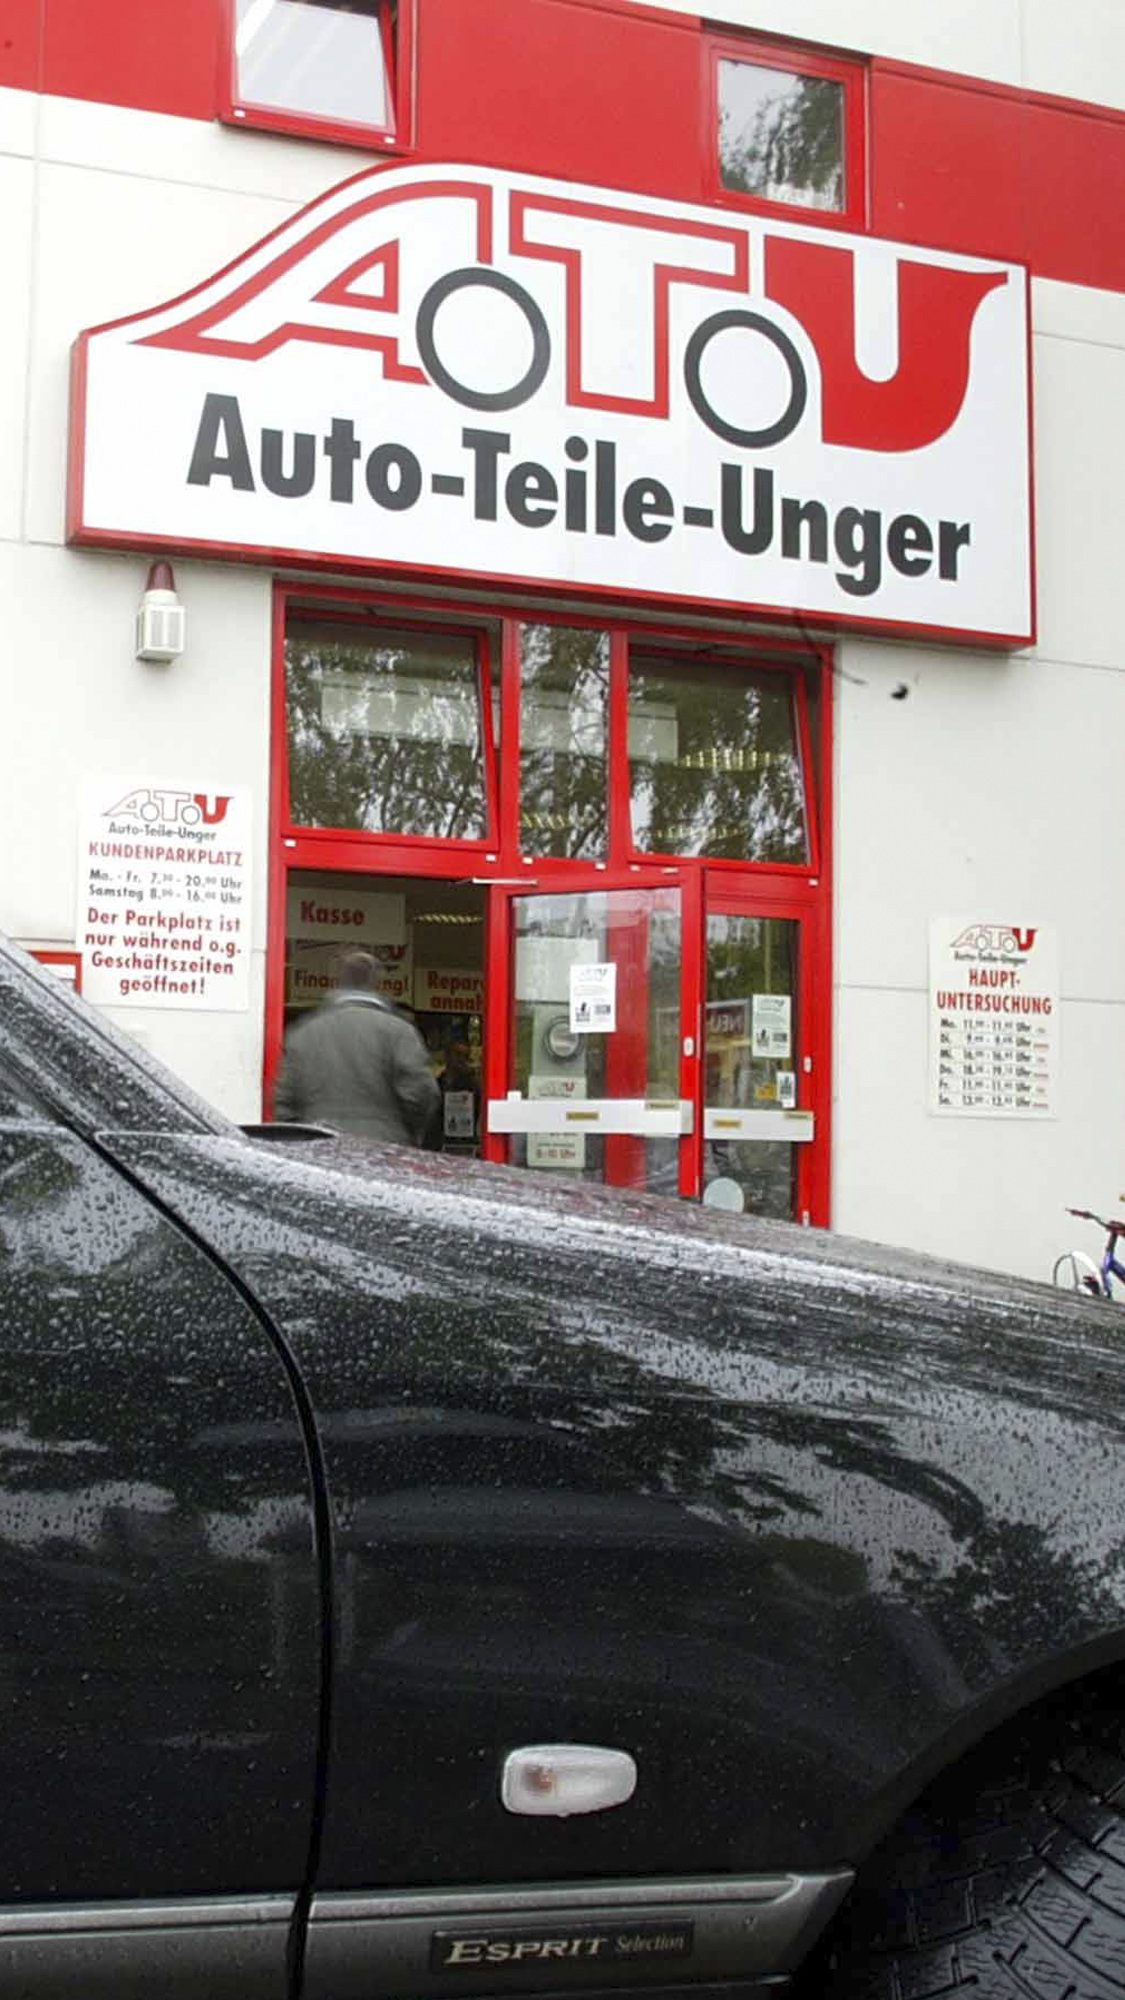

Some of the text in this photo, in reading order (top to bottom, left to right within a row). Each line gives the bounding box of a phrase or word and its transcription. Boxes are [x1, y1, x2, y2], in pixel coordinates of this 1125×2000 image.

[186, 392, 970, 597] Auto-Teile-Unger
[108, 821, 217, 843] Auto-Teile-Unger
[89, 841, 243, 867] KUNDENPARKPLATZ
[89, 884, 144, 902] Samstag
[220, 892, 242, 903] Uhr
[220, 877, 242, 889] Uhr
[87, 907, 241, 933] Der Parkplatz ist
[301, 900, 364, 926] Kasse
[85, 931, 242, 958] nur während o.g.
[91, 951, 234, 974] Geschäftszeiten
[120, 976, 205, 995] geöffnet!
[969, 968, 1020, 987] HAUPT-
[937, 991, 1052, 1015] UNTERSUCHUNG
[614, 1933, 686, 1952] Selection
